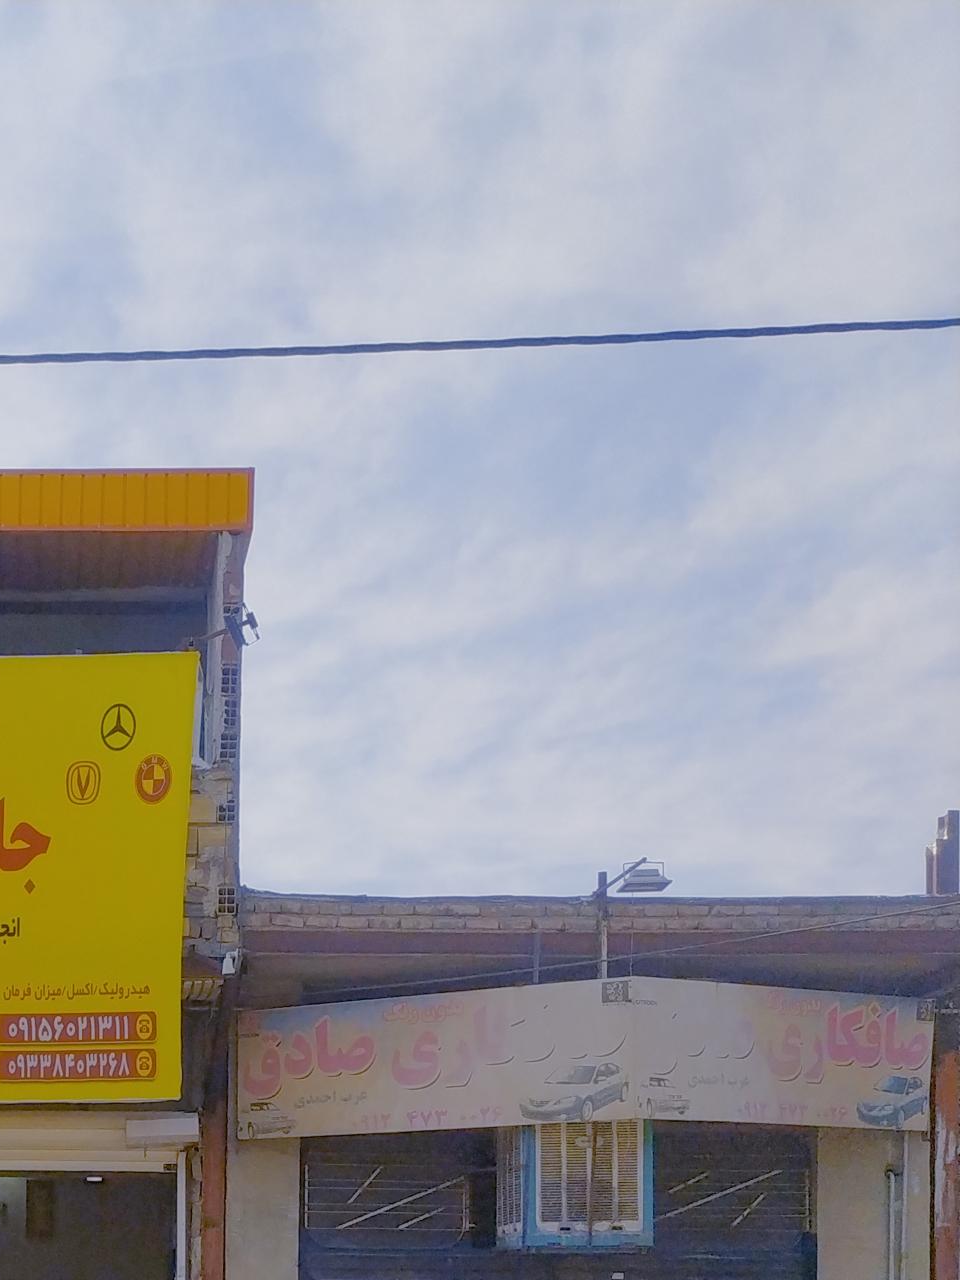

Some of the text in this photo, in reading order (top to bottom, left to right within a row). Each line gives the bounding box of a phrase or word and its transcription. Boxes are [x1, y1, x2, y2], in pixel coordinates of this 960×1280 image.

[2, 983, 32, 1001] فرمان
[8, 1015, 130, 1042] ۰۹۱۵۶۰۲۱۳۱۱
[768, 1000, 929, 1084] صافکاری
[8, 1052, 131, 1079] ۰۹۳۳۸۴۰۳۲۶۸
[243, 1015, 378, 1100] صادق
